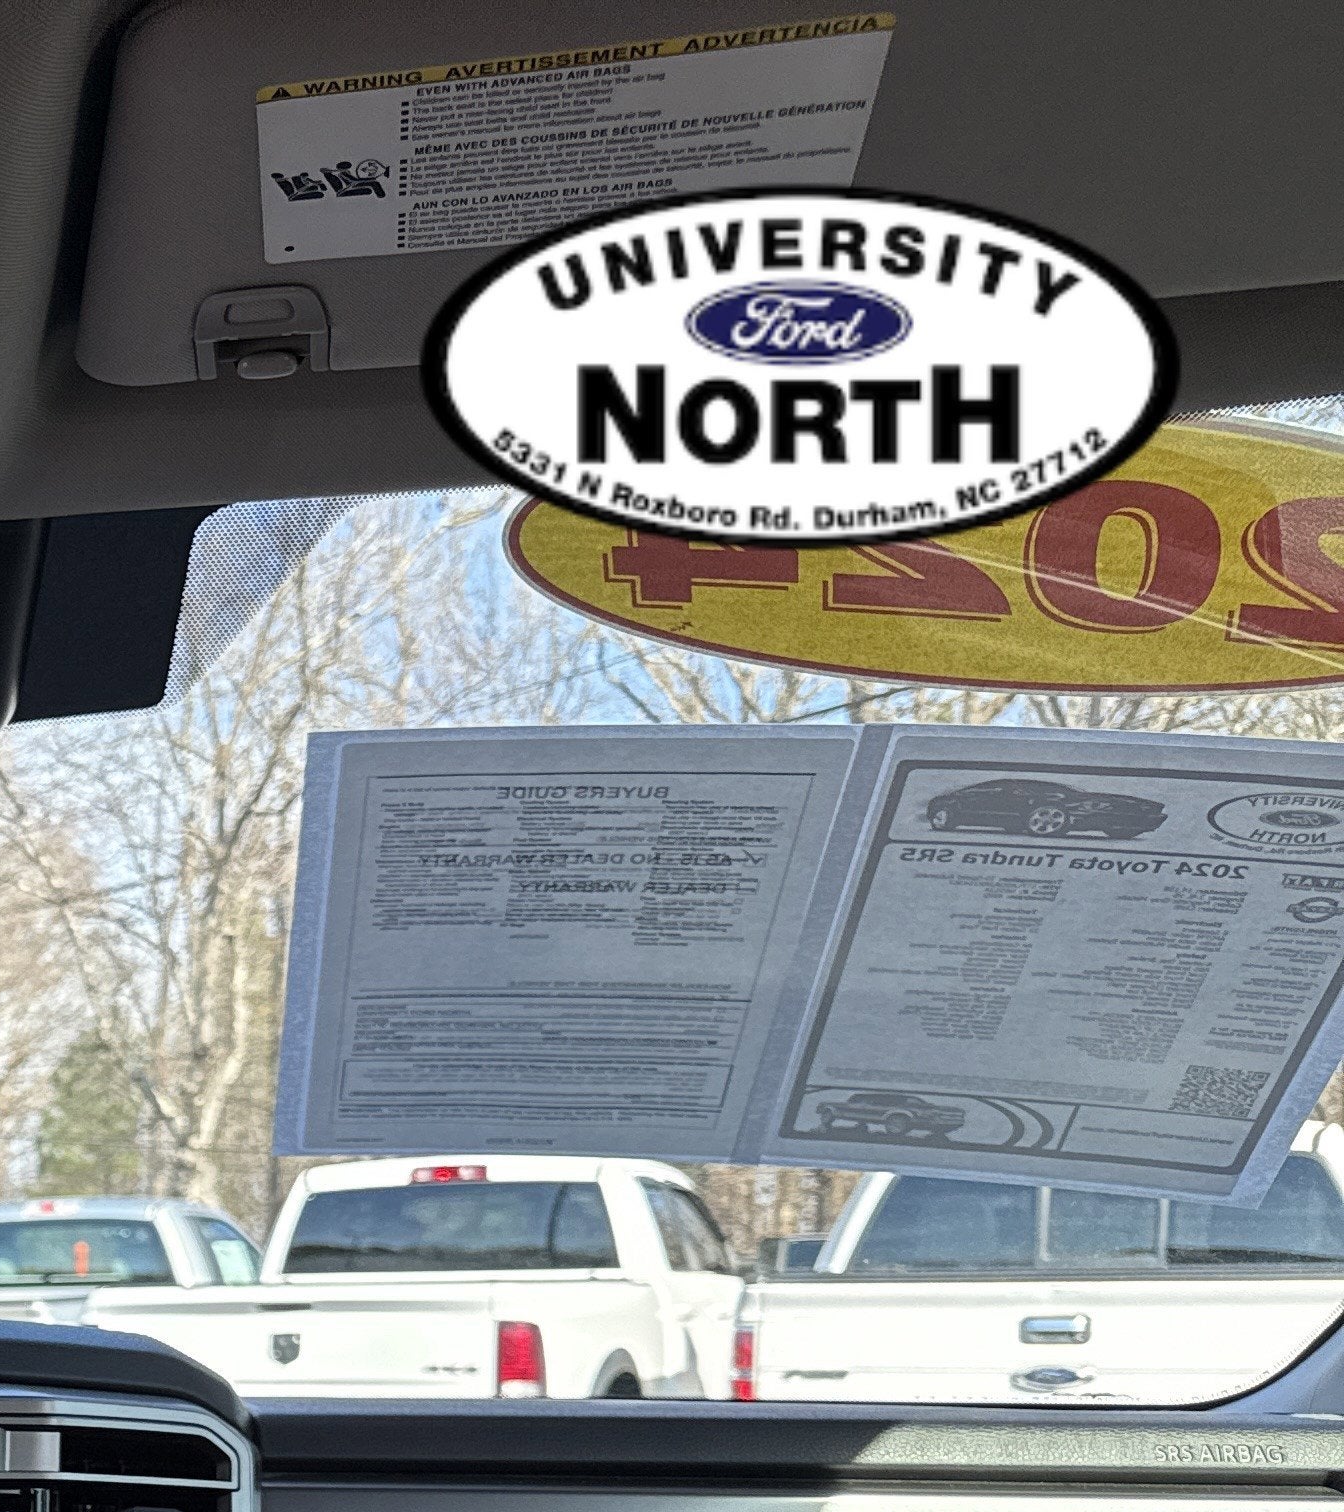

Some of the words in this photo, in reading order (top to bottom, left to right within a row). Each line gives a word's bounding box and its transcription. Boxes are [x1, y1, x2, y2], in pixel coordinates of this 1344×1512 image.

[304, 71, 423, 94] WARNING
[445, 43, 664, 81] AVERTISSEMENT
[684, 16, 878, 51] ADVERTENCIA
[417, 86, 451, 96] EVEN
[455, 82, 487, 93] WITH
[491, 73, 562, 90] ADVANCED
[566, 69, 589, 80] AIR
[594, 65, 631, 77] BAGS
[1155, 1443, 1194, 1462] SRS
[1200, 1443, 1288, 1464] AIRBAG
